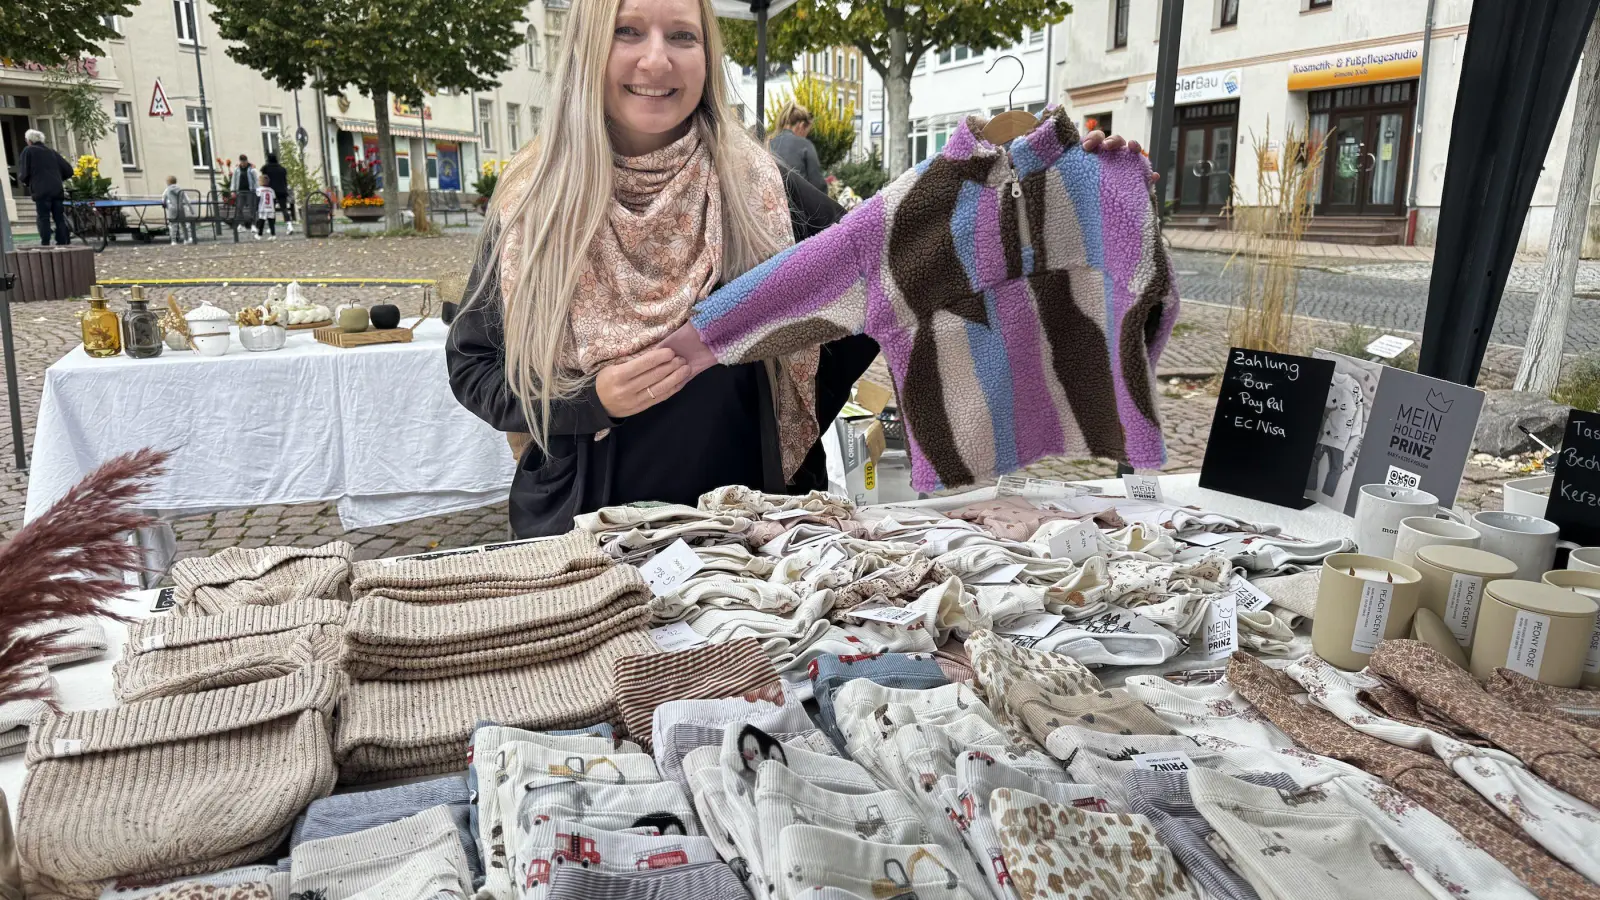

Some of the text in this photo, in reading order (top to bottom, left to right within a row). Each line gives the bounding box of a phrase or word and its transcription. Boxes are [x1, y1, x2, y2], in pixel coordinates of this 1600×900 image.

[1293, 48, 1418, 74] Kosmetik- & Fußpflegestudio
[1175, 76, 1218, 92] olarBau
[1233, 351, 1300, 381] Zahlung
[1241, 372, 1274, 390] Bar
[1397, 404, 1443, 433] MEIN
[1393, 422, 1437, 446] HOLDER
[1389, 435, 1433, 461] PRINZ
[866, 465, 874, 486] 5310
[1243, 595, 1260, 609] INZ
[1465, 582, 1476, 606] PEACH
[1371, 589, 1388, 637] PEACH SCENT
[1460, 606, 1471, 630] SCENT
[1207, 619, 1231, 636] MEIN
[1207, 630, 1231, 643] HOLDER
[1208, 637, 1232, 651] PRINZ
[1525, 620, 1543, 668] PEONY ROSE
[1149, 762, 1189, 772] PRINZ
